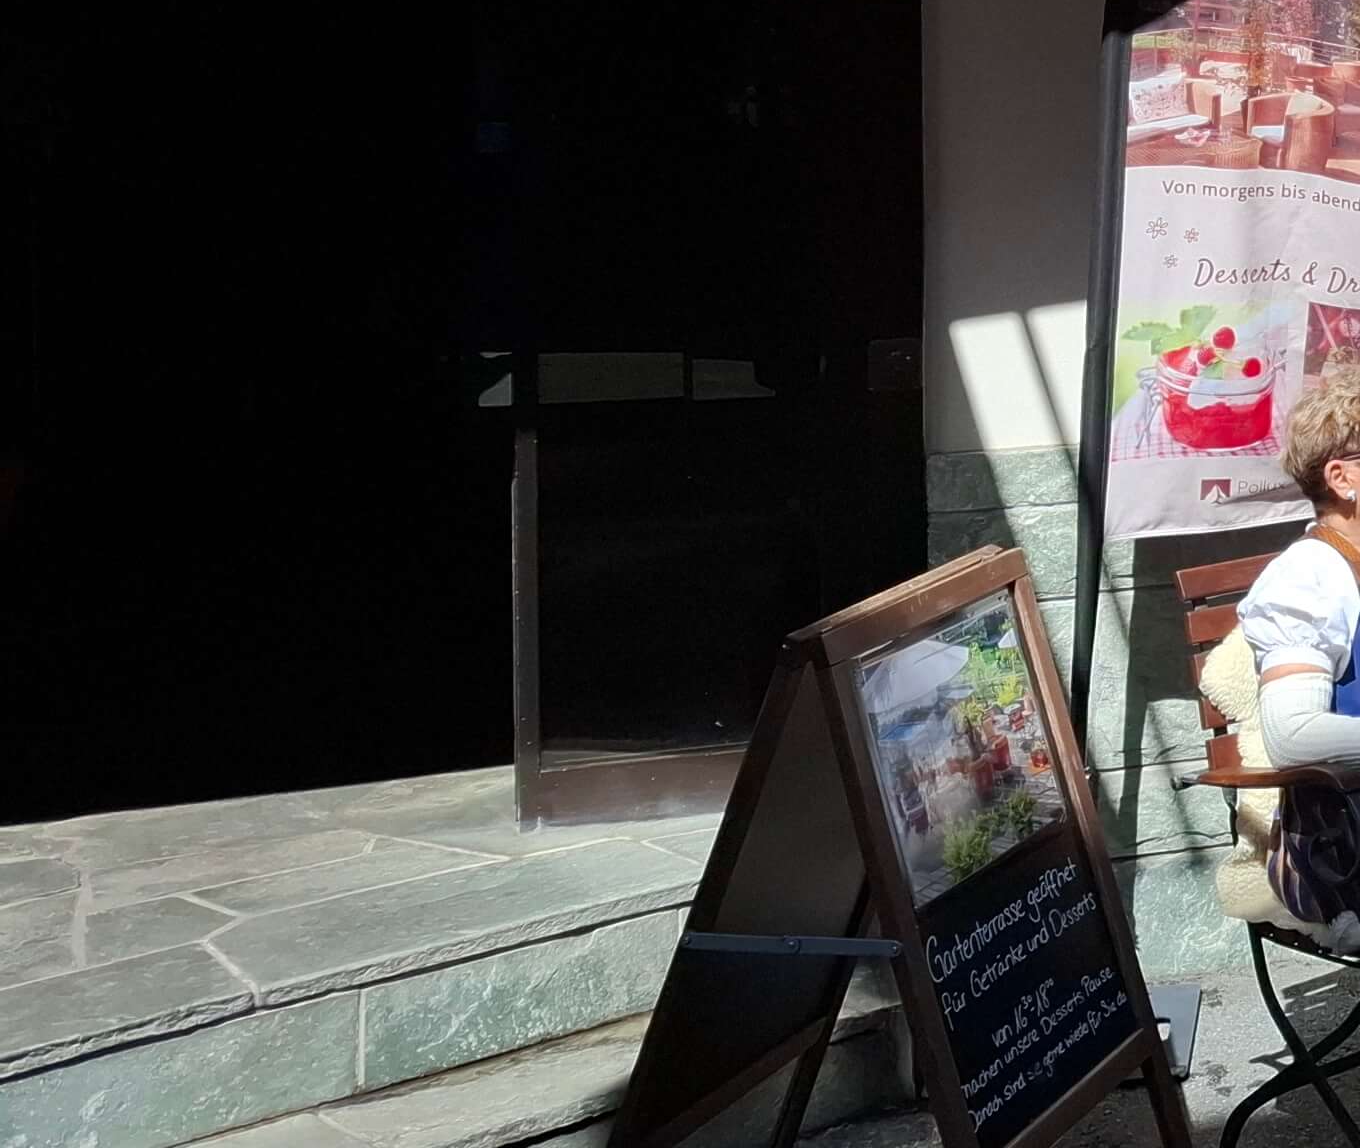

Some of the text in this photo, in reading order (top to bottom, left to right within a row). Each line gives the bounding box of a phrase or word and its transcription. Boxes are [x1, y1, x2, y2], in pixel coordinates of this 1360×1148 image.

[1162, 179, 1197, 196] Von
[1202, 182, 1275, 202] morgens
[1281, 182, 1306, 200] bis
[1193, 257, 1291, 287] Desserts
[1301, 261, 1318, 286] &
[926, 856, 1078, 984] Gartenterrasse geöffnet
[940, 892, 1097, 1032] für Getränke und Desserts
[991, 1024, 1014, 1049] von
[1004, 1029, 1041, 1065] unsere
[1080, 966, 1114, 997] Pause
